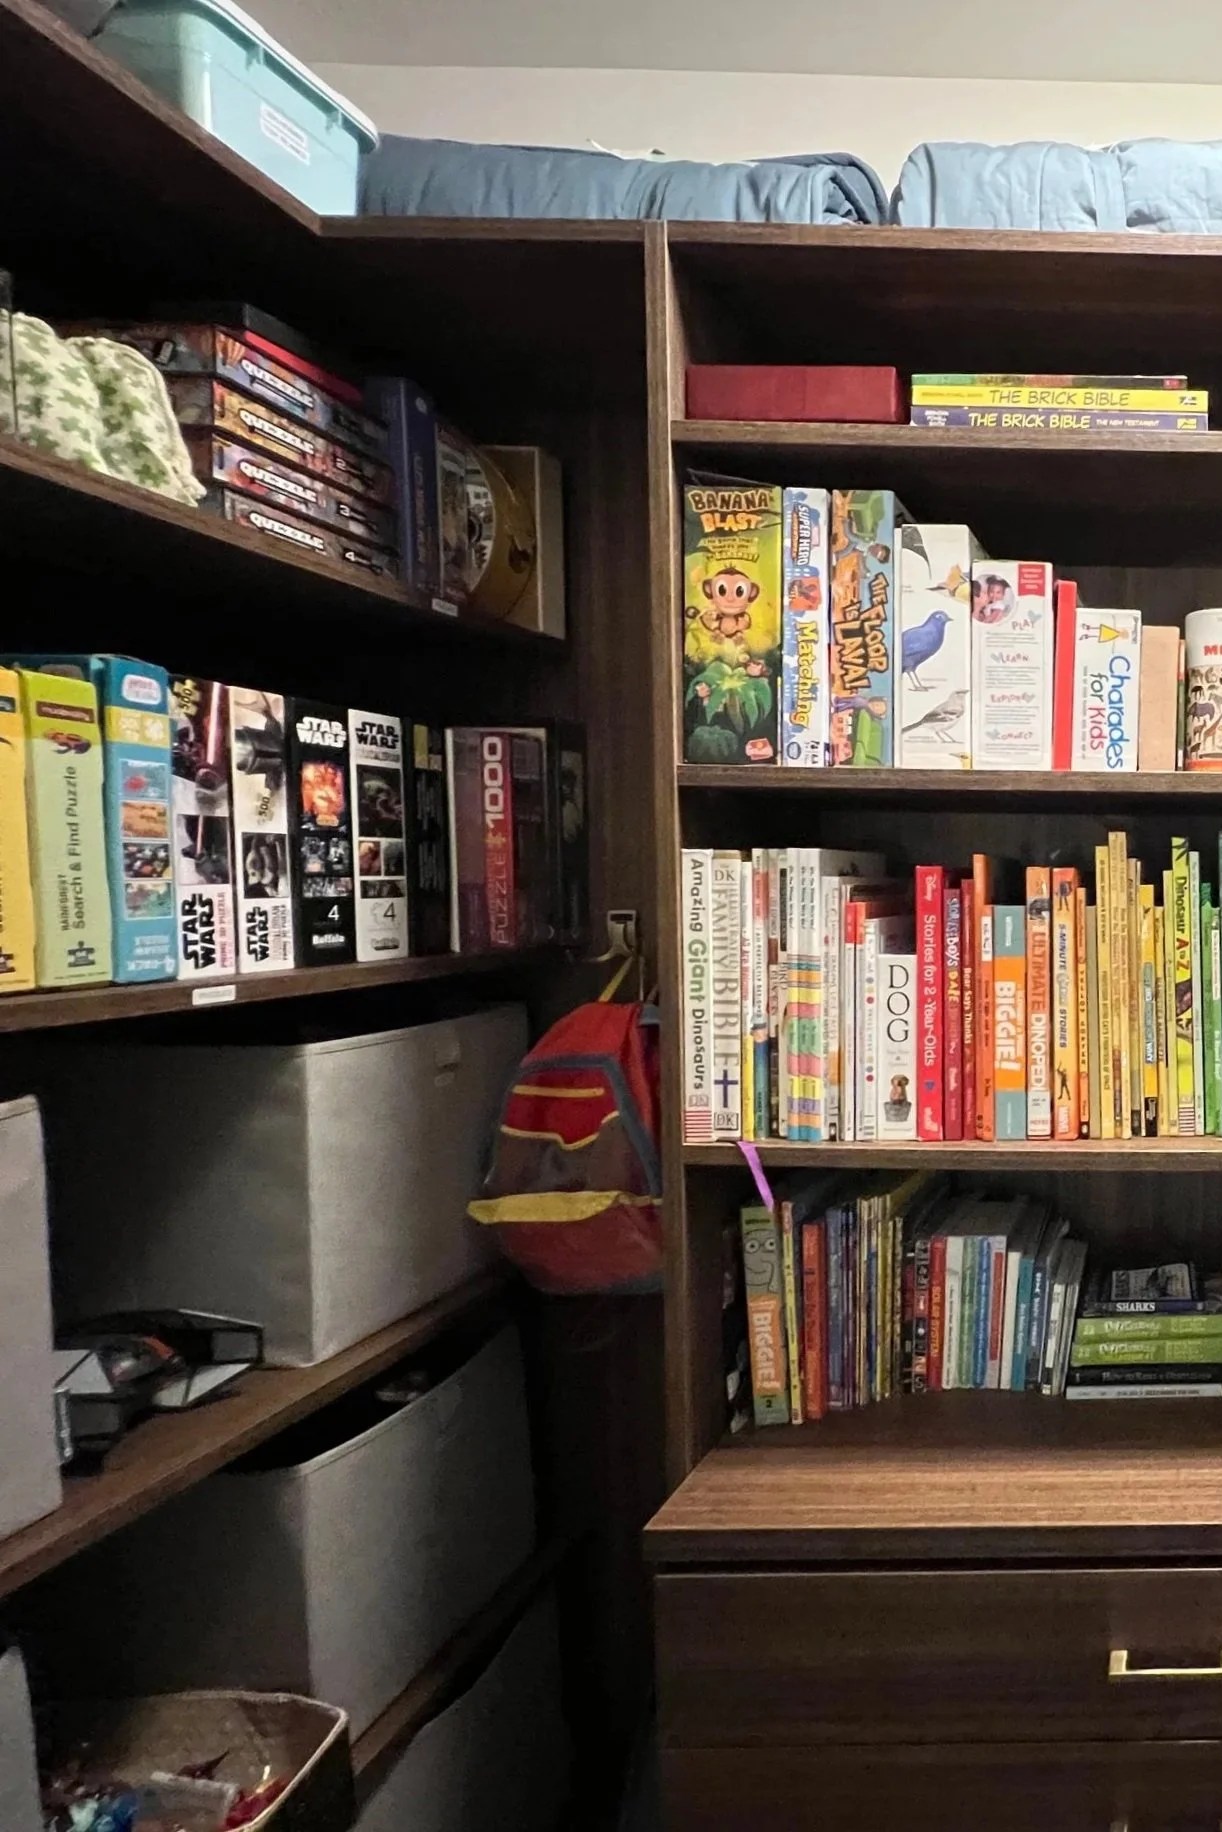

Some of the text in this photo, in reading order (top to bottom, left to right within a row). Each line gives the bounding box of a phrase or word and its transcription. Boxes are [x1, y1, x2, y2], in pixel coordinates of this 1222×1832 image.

[968, 412, 997, 427] THE
[1002, 413, 1045, 428] BRICK
[1050, 413, 1091, 429] BIBLE
[1128, 419, 1160, 427] TESTAMENT
[989, 390, 1130, 406] THE BRICK BIBLE
[688, 490, 771, 512] BANANA
[701, 512, 762, 533] BLAST
[796, 504, 811, 565] SUPER HERO
[860, 572, 890, 674] THE FLOOR
[1011, 619, 1036, 631] PLAY
[789, 620, 818, 728] Matching
[1001, 652, 1030, 664] LEARN
[296, 716, 346, 735] STAR
[355, 721, 399, 738] STAR
[1087, 672, 1109, 751] for Kids
[1106, 655, 1131, 769] Charades
[298, 731, 347, 748] WARS
[356, 735, 400, 750] WARS
[483, 735, 505, 829] 1000
[66, 766, 85, 929] Search & Find Puzzle
[328, 905, 339, 921] 4
[383, 902, 396, 921] 4
[924, 873, 938, 901] Disney
[182, 893, 198, 969] STAR
[198, 893, 216, 969] WARS
[246, 907, 258, 962] STAR
[256, 907, 269, 962] WARS
[728, 888, 739, 969] ILLUSTRATED
[925, 914, 938, 963] Stories
[1175, 875, 1190, 972] Dinosaur A TO Z
[688, 858, 708, 1090] Amazing Giant Dinosaurs
[712, 888, 739, 1067] FAMILY BIBLE
[925, 964, 939, 983] for
[945, 936, 960, 967] BOYS
[887, 963, 910, 1043] DOG
[947, 969, 960, 1003] DARE
[963, 967, 974, 1044] Bear Says Thanks
[1031, 931, 1046, 1092] ULTIMATE DINOPEDI
[1059, 923, 1069, 1048] 5-MINUTE STORIES
[995, 981, 1022, 1070] BIGGIE!
[1146, 1041, 1154, 1063] WHY
[930, 1285, 943, 1358] SOLAR SYSTEM
[1116, 1302, 1156, 1312] SHARKS
[754, 1311, 780, 1389] BIGGIE!
